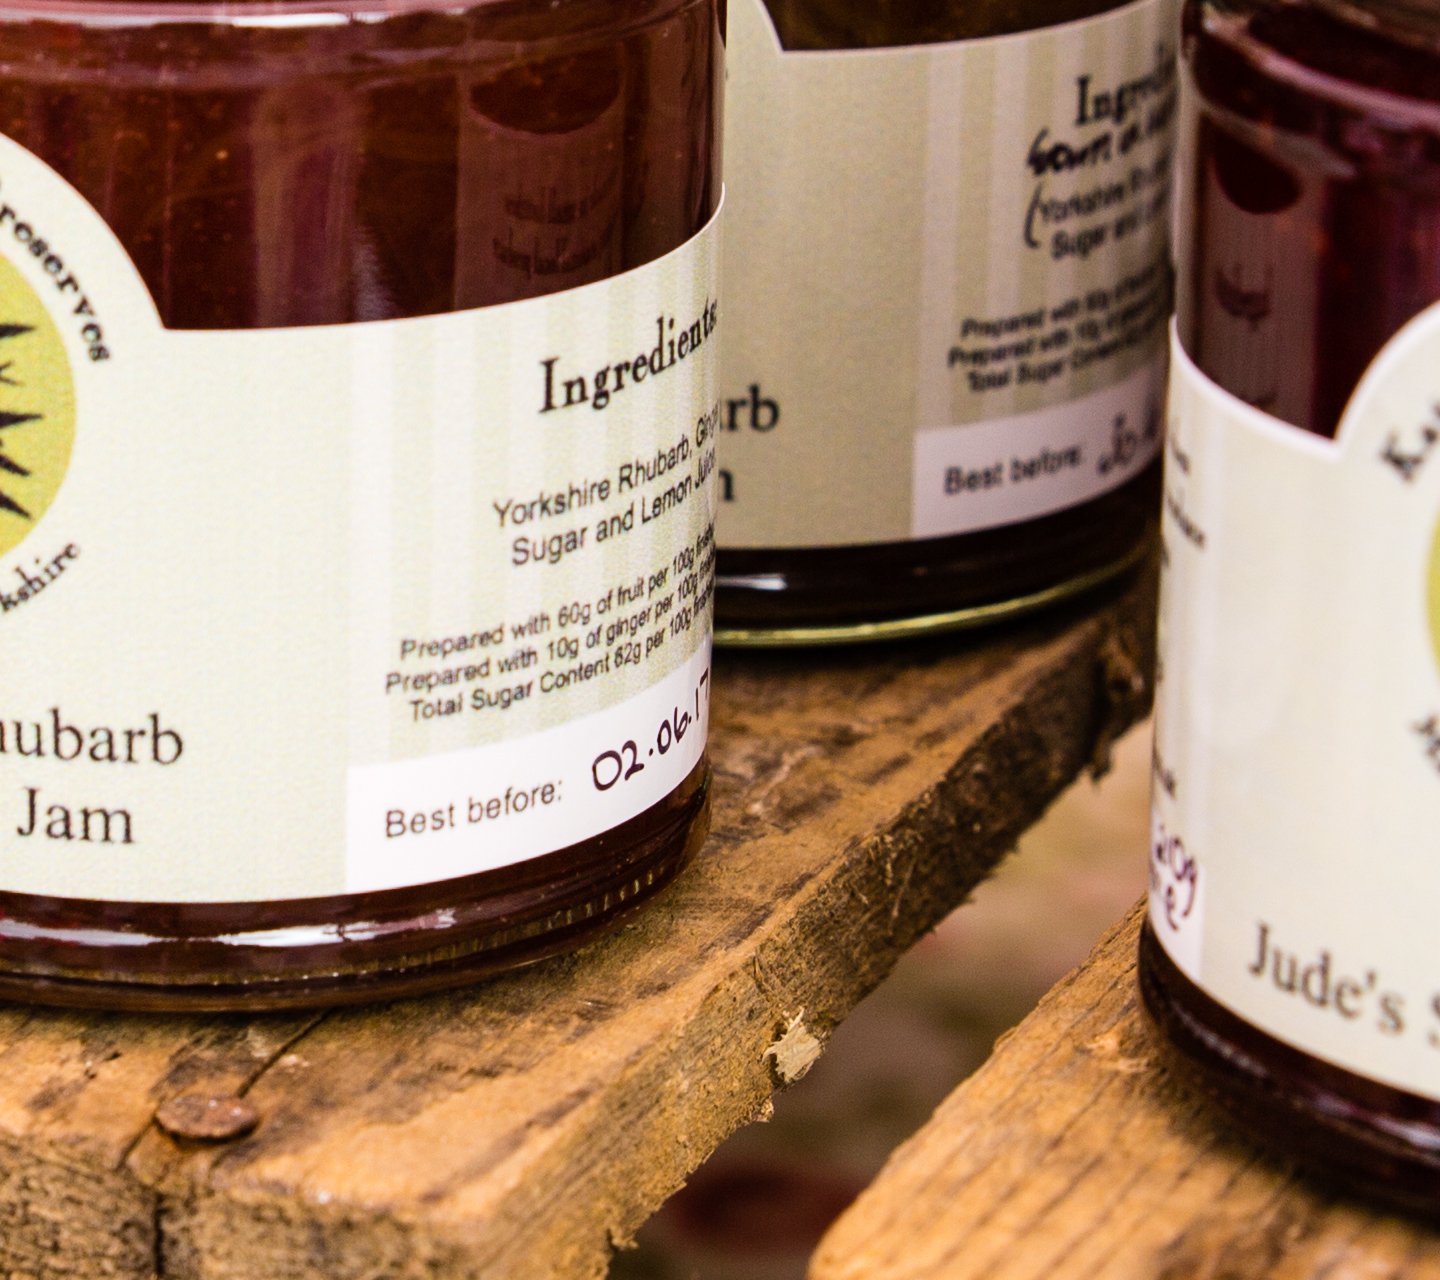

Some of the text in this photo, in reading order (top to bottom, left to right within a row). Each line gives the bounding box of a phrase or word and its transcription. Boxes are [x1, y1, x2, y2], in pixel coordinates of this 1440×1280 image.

[491, 464, 612, 529] Yorkshire
[619, 433, 693, 493] Rhubarb,
[943, 461, 1004, 497] Best
[510, 526, 590, 568] Sugar
[595, 500, 635, 544] and
[641, 472, 693, 524] Lemon
[385, 656, 492, 696] Prepared
[497, 641, 540, 676] with
[585, 622, 604, 651] of
[400, 625, 505, 662] Prepared
[511, 608, 552, 644] with
[596, 590, 614, 619] of
[408, 692, 464, 723] Total
[470, 677, 535, 712] Sugar
[538, 652, 612, 696] Content
[591, 669, 710, 792] 02.06.17
[16, 785, 138, 846] Jam
[385, 779, 564, 840] Best before:
[1249, 922, 1406, 1035] Jude's
